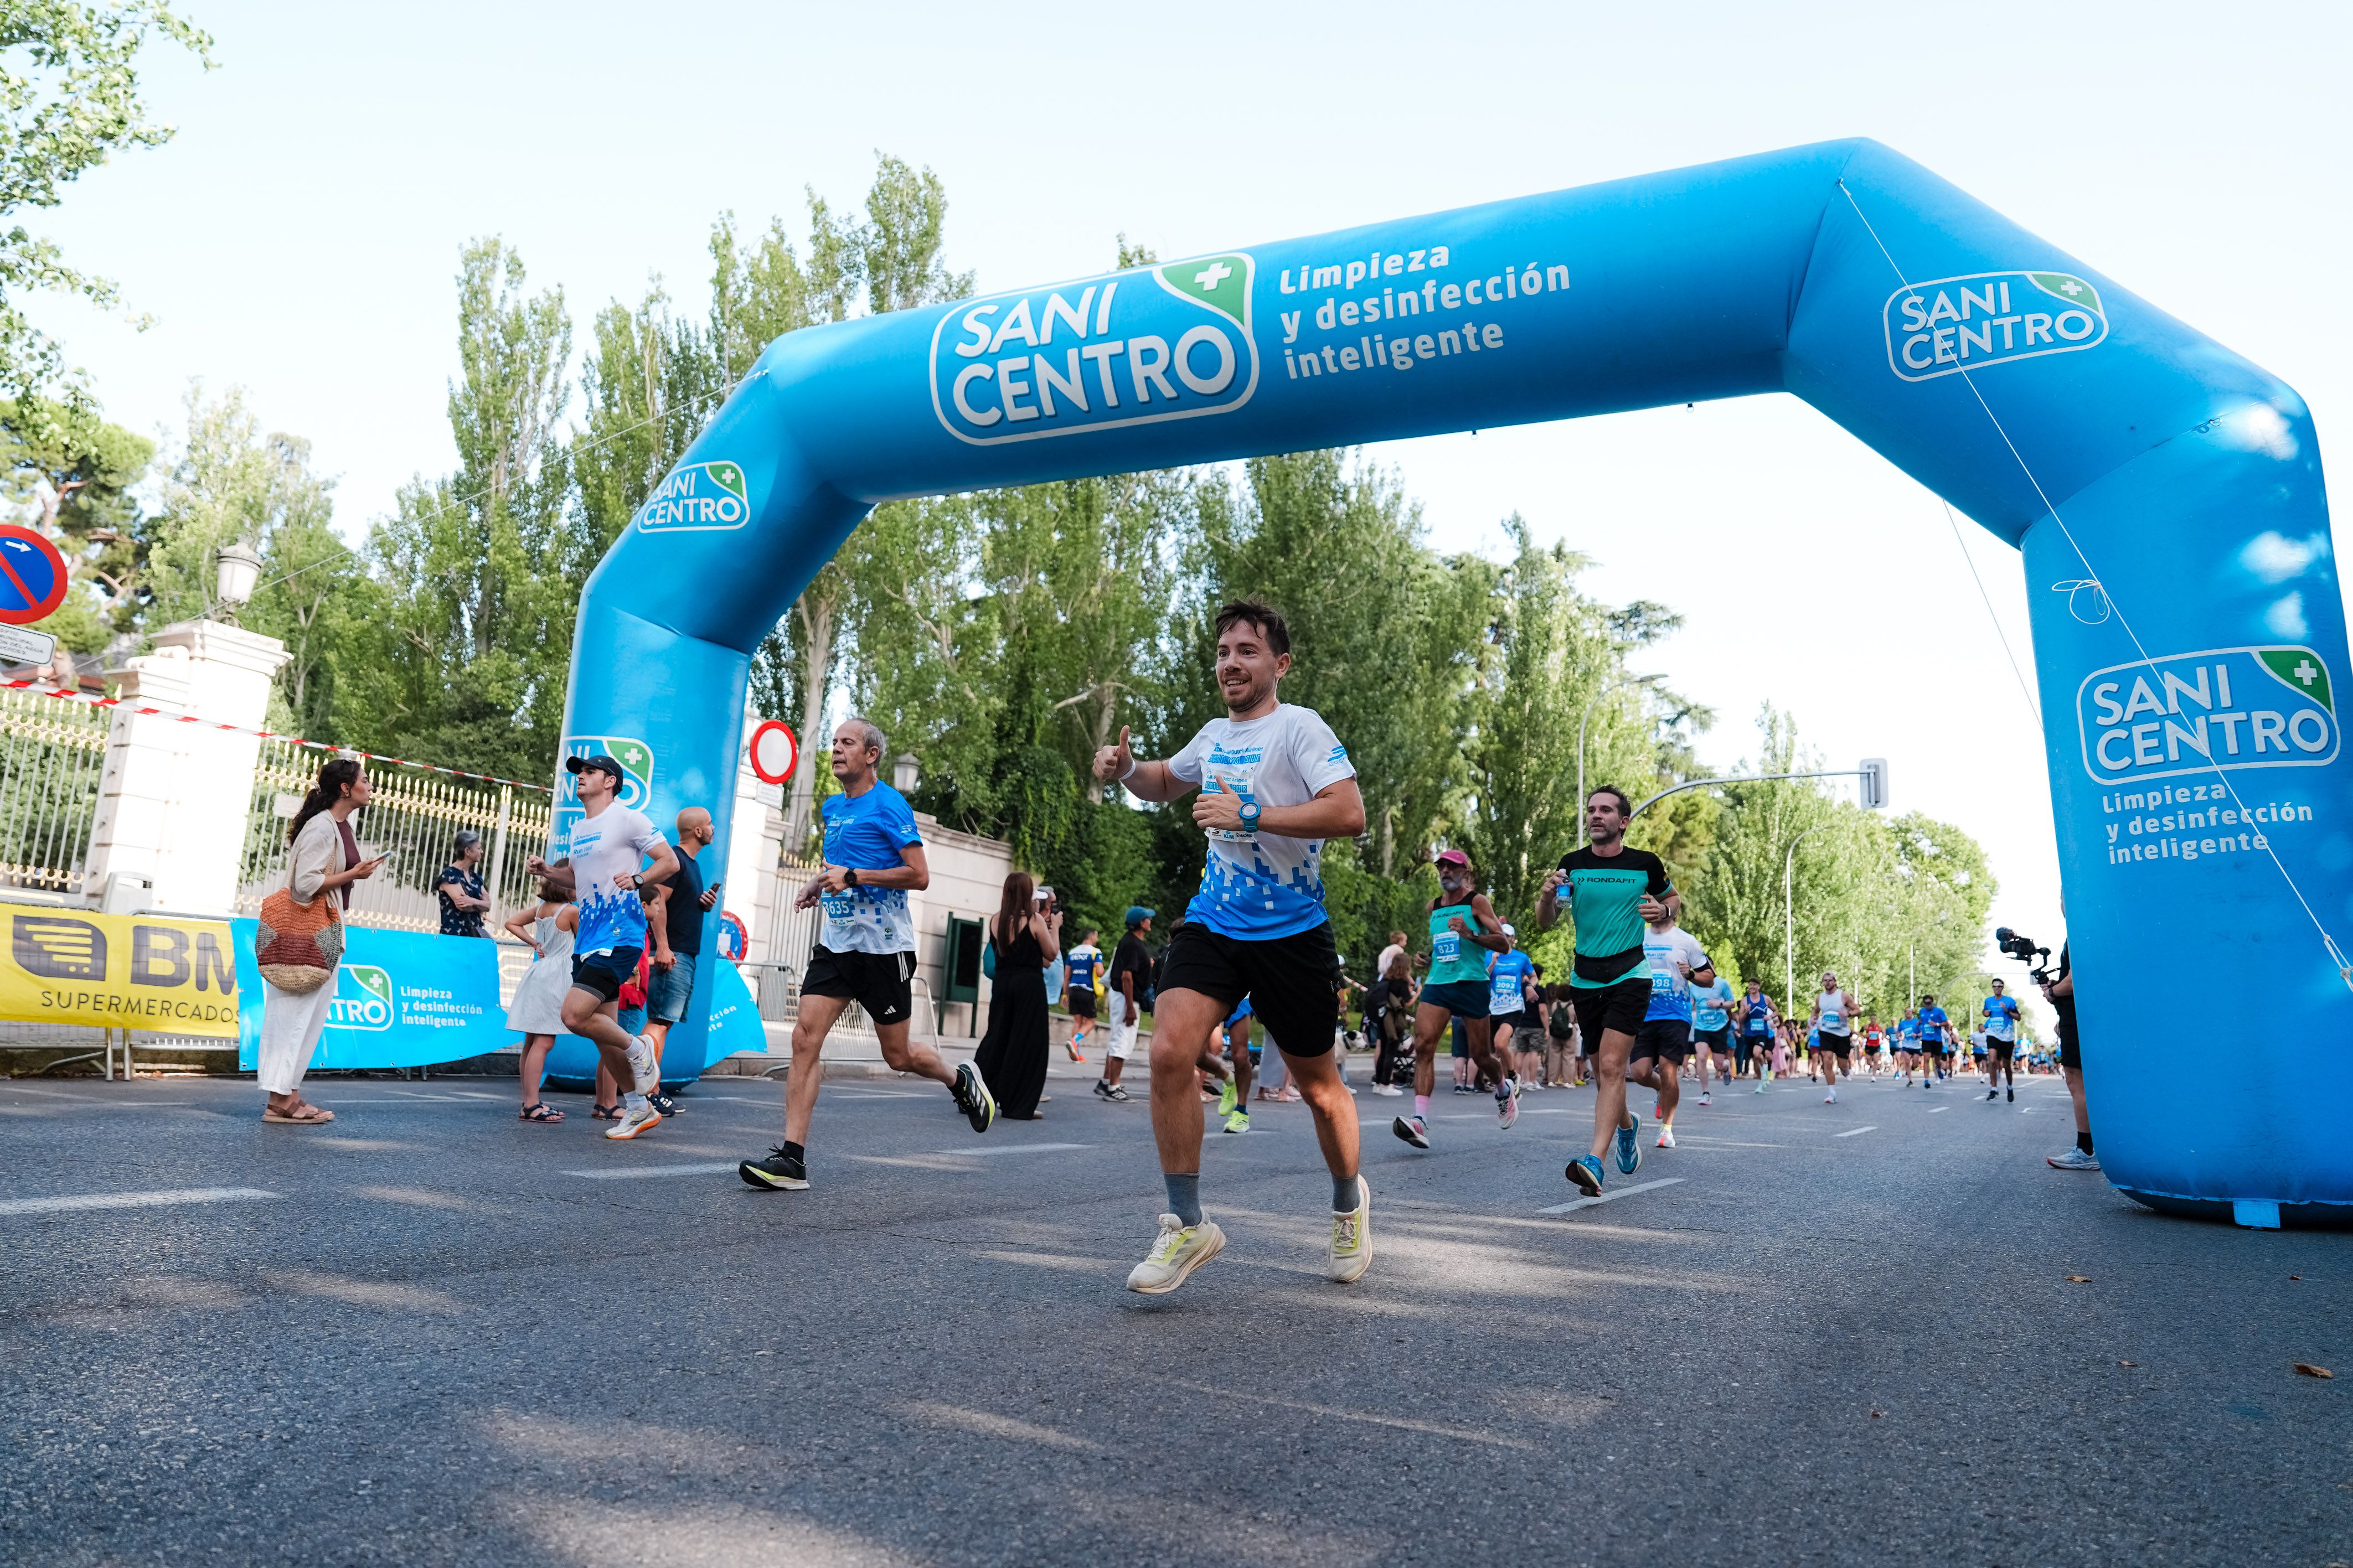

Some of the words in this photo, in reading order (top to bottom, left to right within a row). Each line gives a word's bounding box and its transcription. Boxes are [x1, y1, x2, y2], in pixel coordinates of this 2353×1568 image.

[1279, 245, 1449, 294] Limpieza
[961, 281, 1118, 359] SANI
[1281, 304, 1301, 343] y
[1316, 261, 1570, 332] desinfección
[1901, 282, 2011, 332] SANI
[1284, 321, 1505, 379] inteligente
[1902, 310, 2095, 369] CENTRO
[953, 324, 1236, 427] CENTRO
[643, 496, 741, 525] CENTRO
[2093, 664, 2233, 726] SANI
[2096, 709, 2329, 770] CENTRO
[1233, 784, 1247, 793] SUR
[2102, 783, 2226, 814] Limpieza
[2106, 824, 2119, 843] y
[2128, 801, 2313, 836] desinfección
[2108, 833, 2269, 865] inteligente
[1438, 943, 1455, 954] 823
[400, 986, 452, 1000] Limpieza
[401, 1002, 409, 1012] y
[412, 1000, 483, 1015] desinfección
[402, 1013, 466, 1028] inteligente
